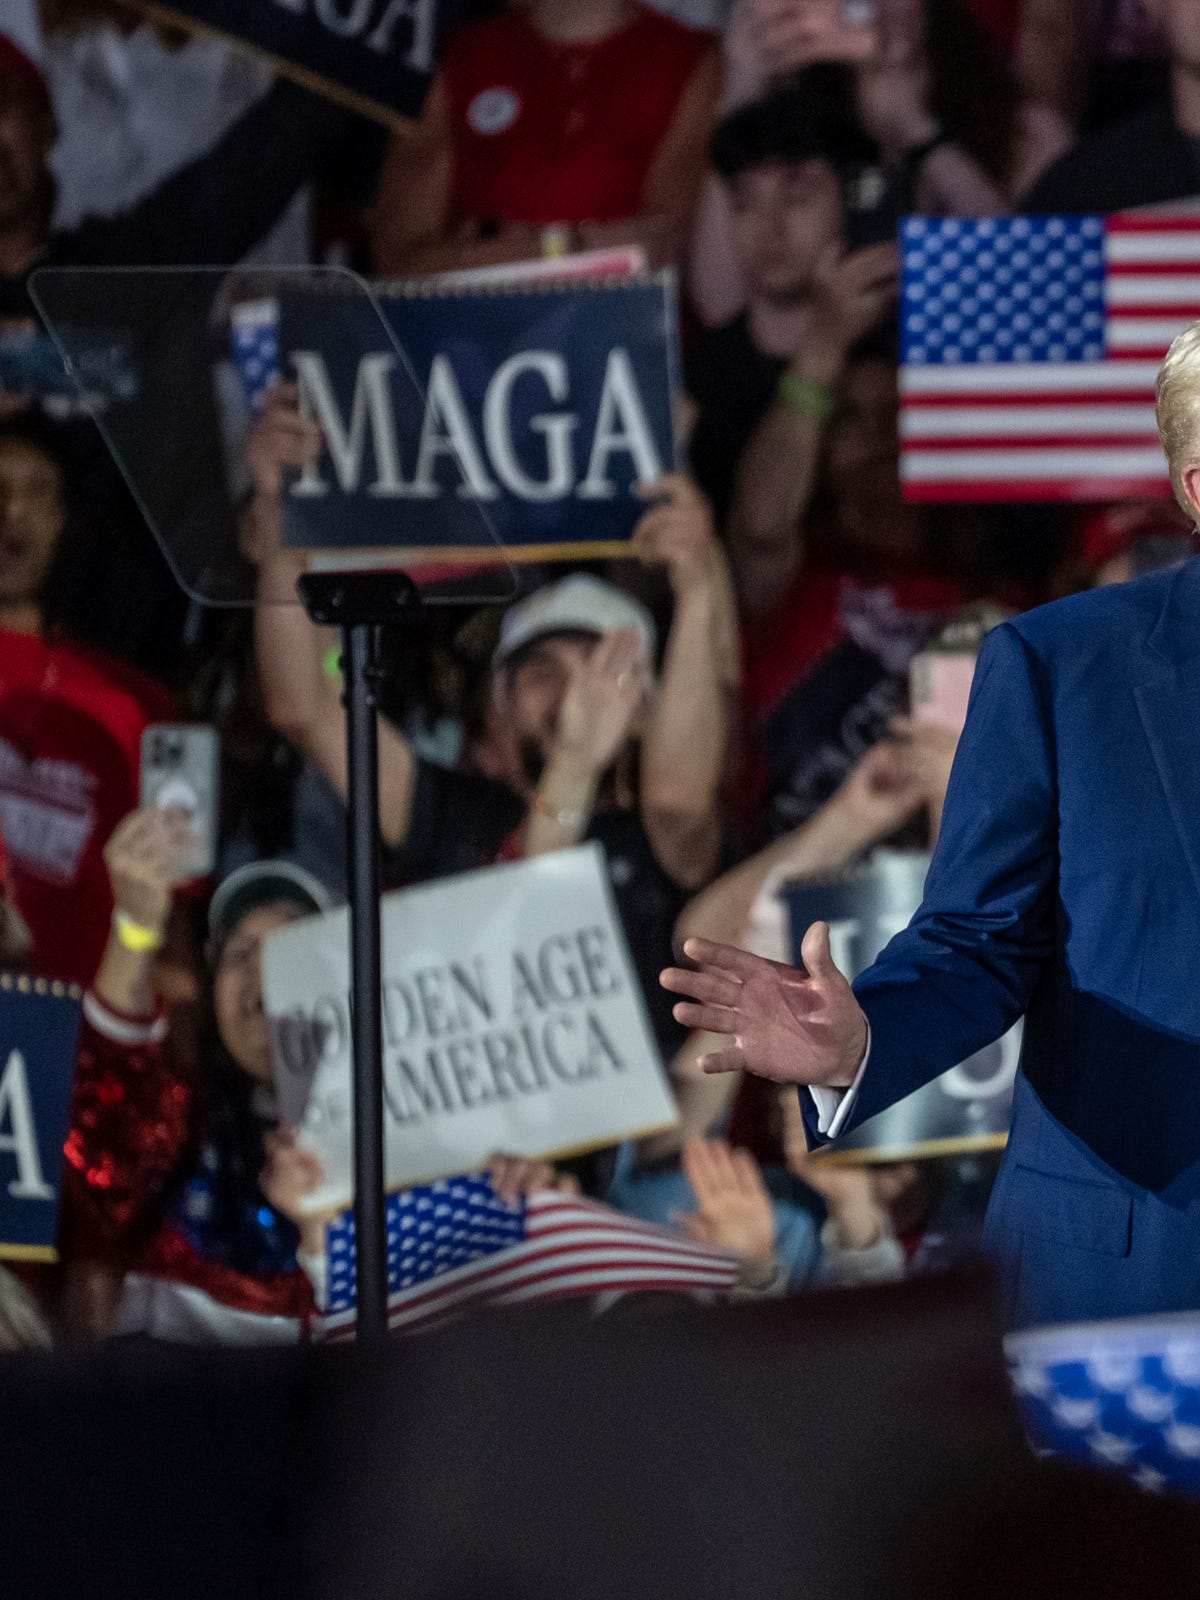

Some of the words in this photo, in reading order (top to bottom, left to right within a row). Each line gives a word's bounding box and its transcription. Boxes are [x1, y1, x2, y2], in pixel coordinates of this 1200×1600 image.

[288, 346, 662, 504] MAGA
[279, 953, 494, 1078] GODEN
[512, 924, 624, 1016] AGE
